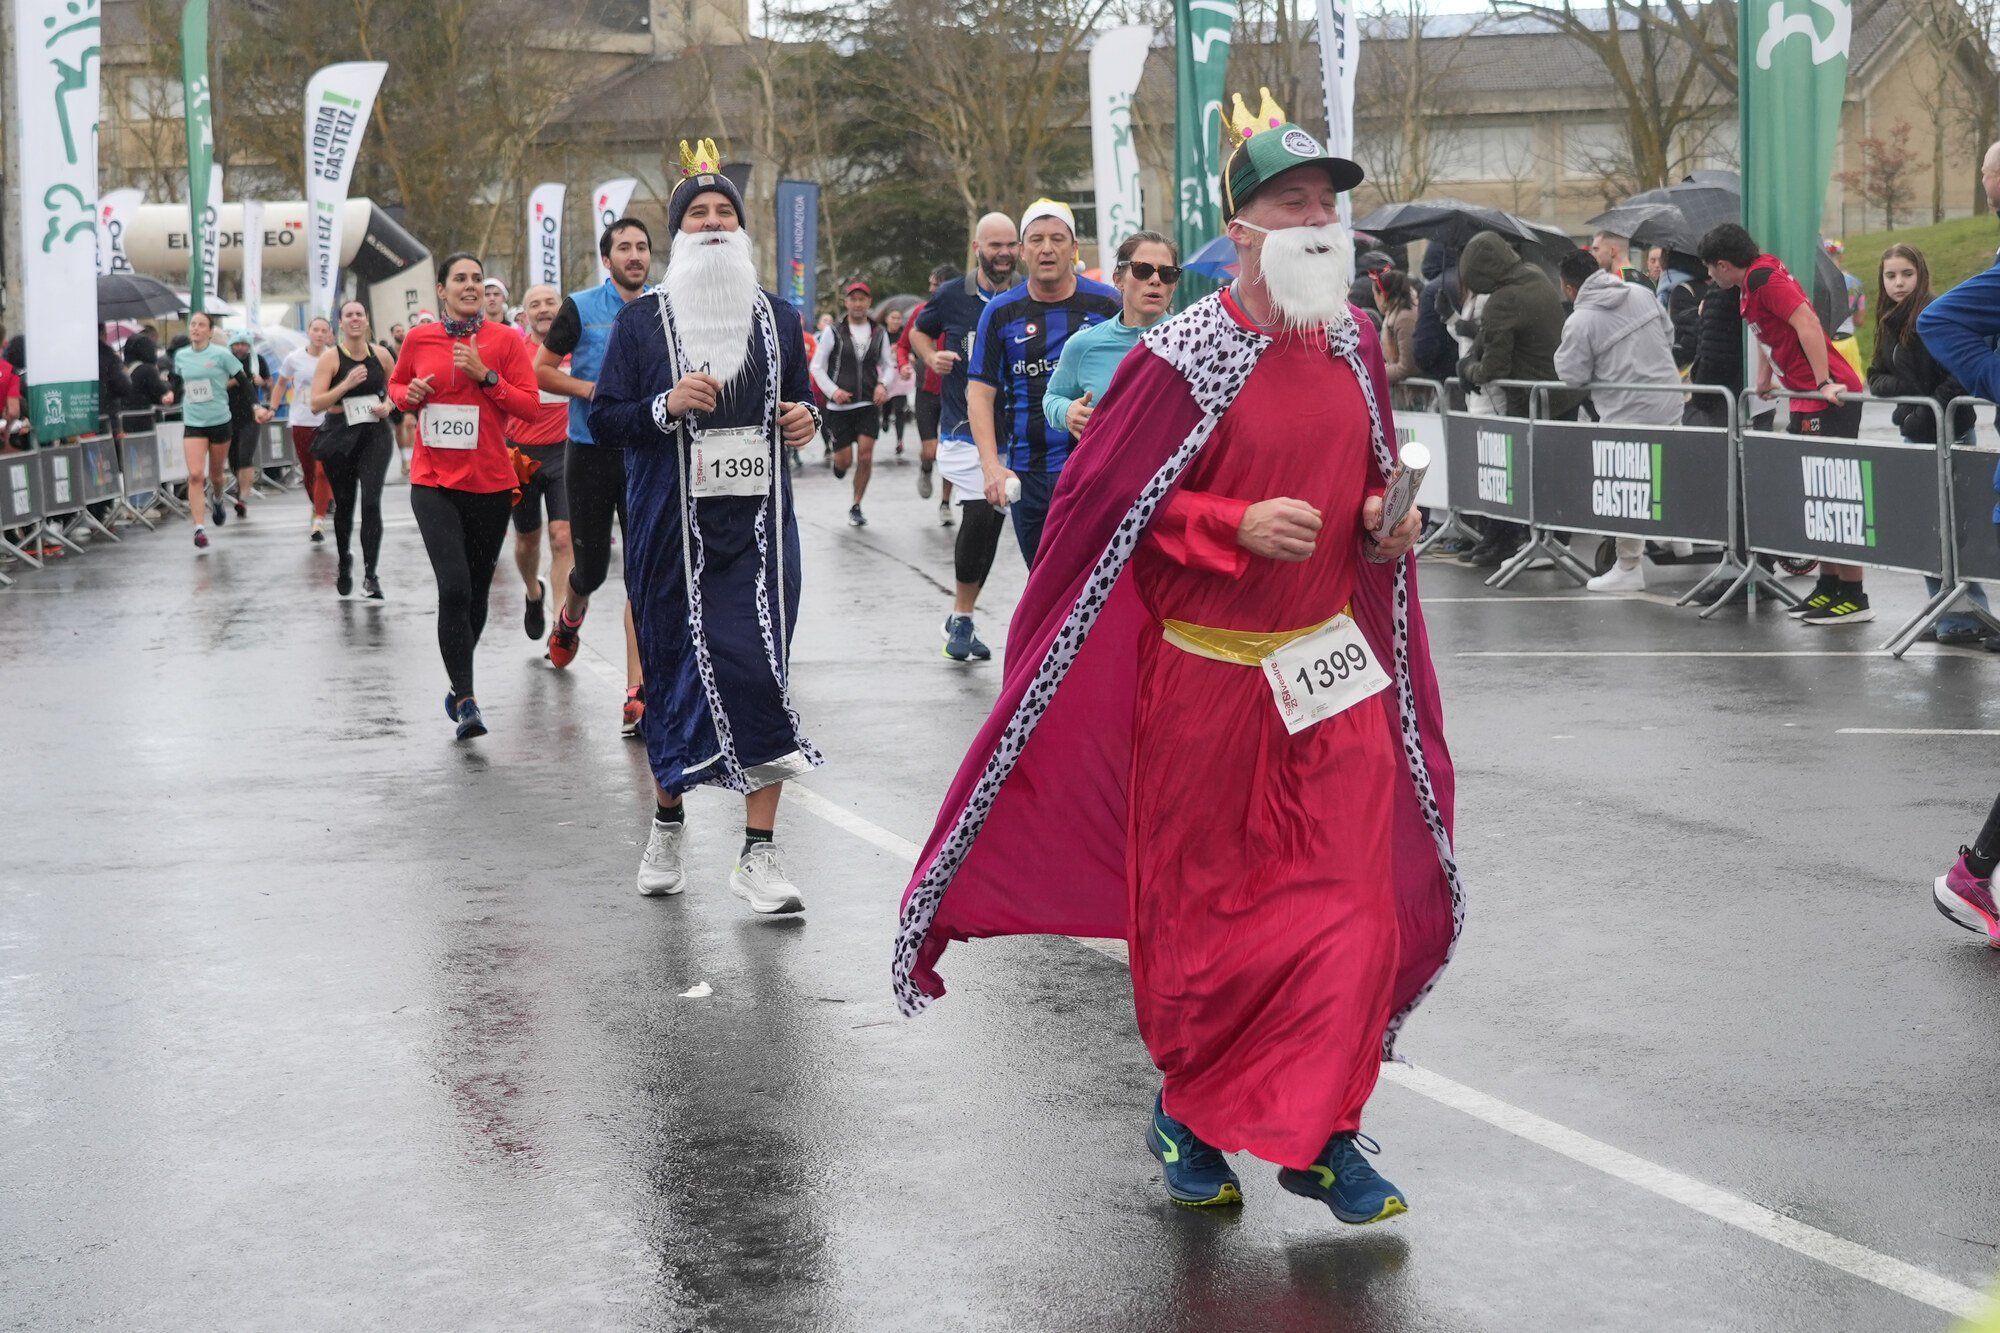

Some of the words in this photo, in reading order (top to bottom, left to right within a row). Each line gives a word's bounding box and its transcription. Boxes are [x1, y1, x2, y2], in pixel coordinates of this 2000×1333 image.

[324, 110, 357, 181] GASTEIZ
[432, 420, 474, 435] 1260
[711, 457, 764, 478] 1398
[1477, 430, 1506, 467] VITORIA
[1592, 440, 1650, 479] VITORIA
[1478, 466, 1507, 504] GASTEIZ
[1801, 455, 1863, 501] VITORIA
[1592, 479, 1650, 520] GASTEIZ
[1804, 500, 1866, 546] GASTEIZ
[1297, 643, 1367, 695] 1399
